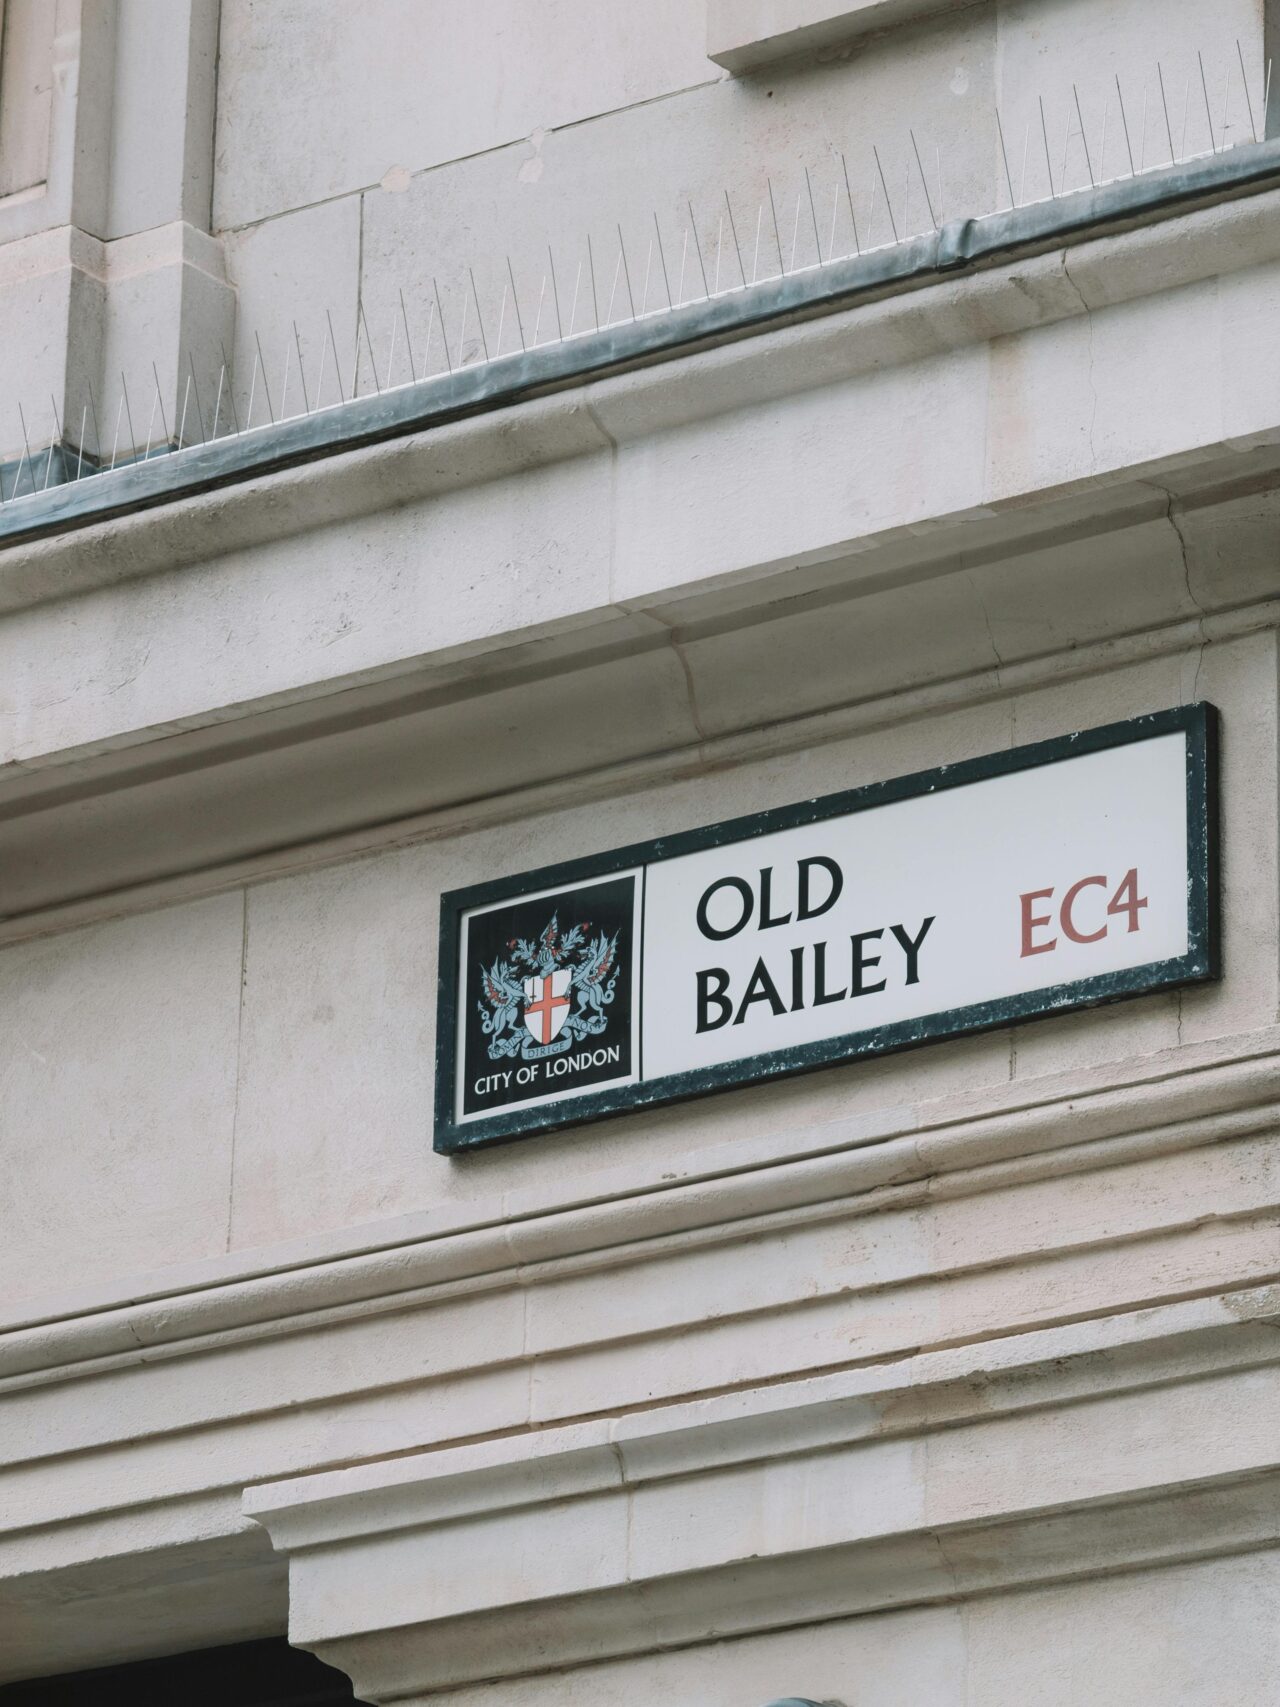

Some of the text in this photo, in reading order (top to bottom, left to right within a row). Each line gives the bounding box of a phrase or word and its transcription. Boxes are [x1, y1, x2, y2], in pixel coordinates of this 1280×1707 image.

[696, 855, 844, 941] OLD
[1019, 867, 1149, 958] EC4
[695, 915, 936, 1034] BAILEY
[474, 1045, 620, 1094] CITY OF LONDON
[527, 1041, 565, 1058] DIRIGE
